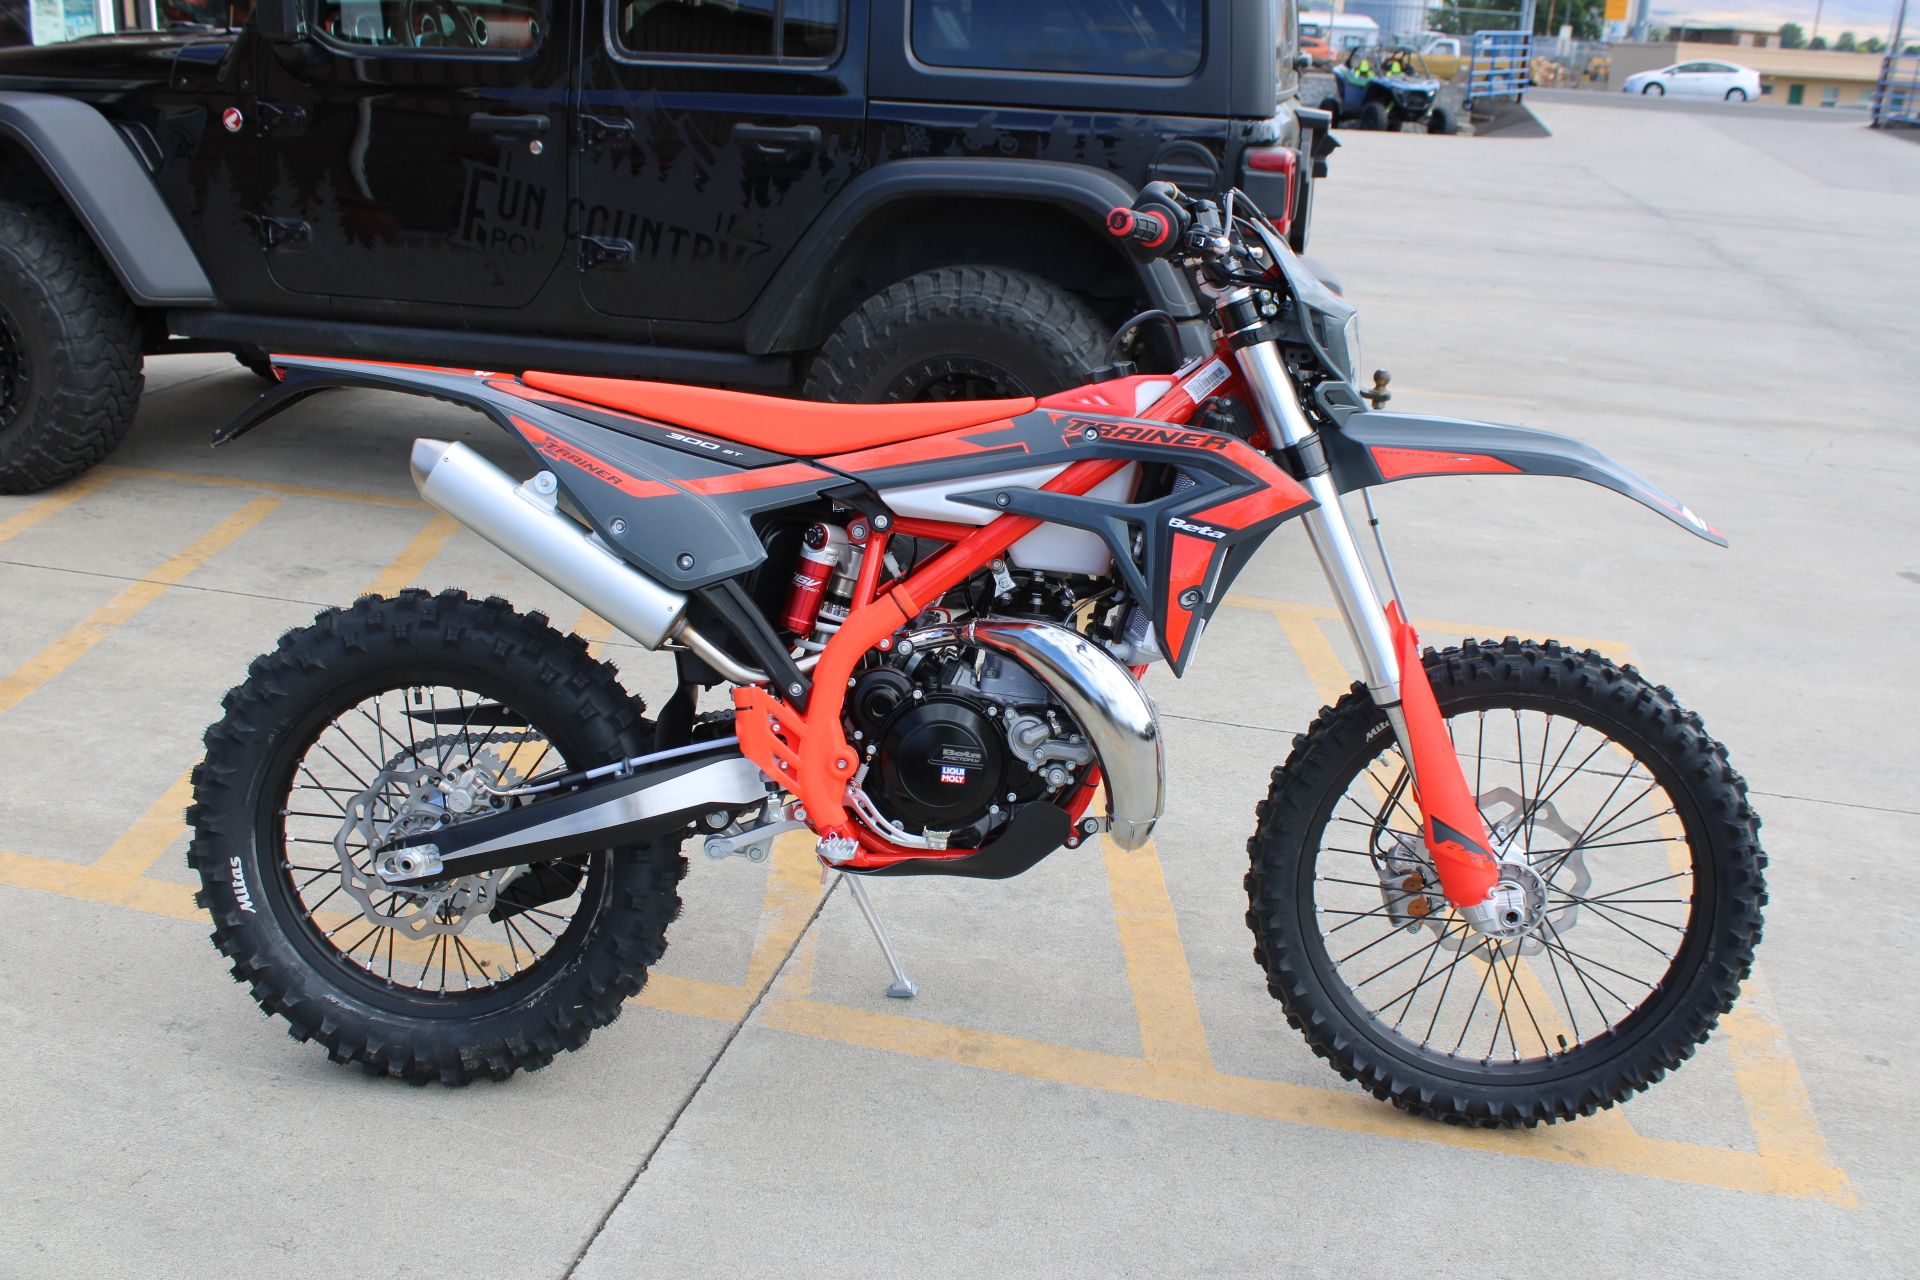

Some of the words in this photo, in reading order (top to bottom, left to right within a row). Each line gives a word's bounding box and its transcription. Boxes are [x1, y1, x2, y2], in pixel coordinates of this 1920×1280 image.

[461, 166, 547, 241] FUN
[665, 432, 721, 451] 300
[1168, 517, 1227, 540] Beta
[942, 748, 982, 759] Beta
[941, 774, 966, 783] MOLY
[942, 766, 966, 776] LIQUI
